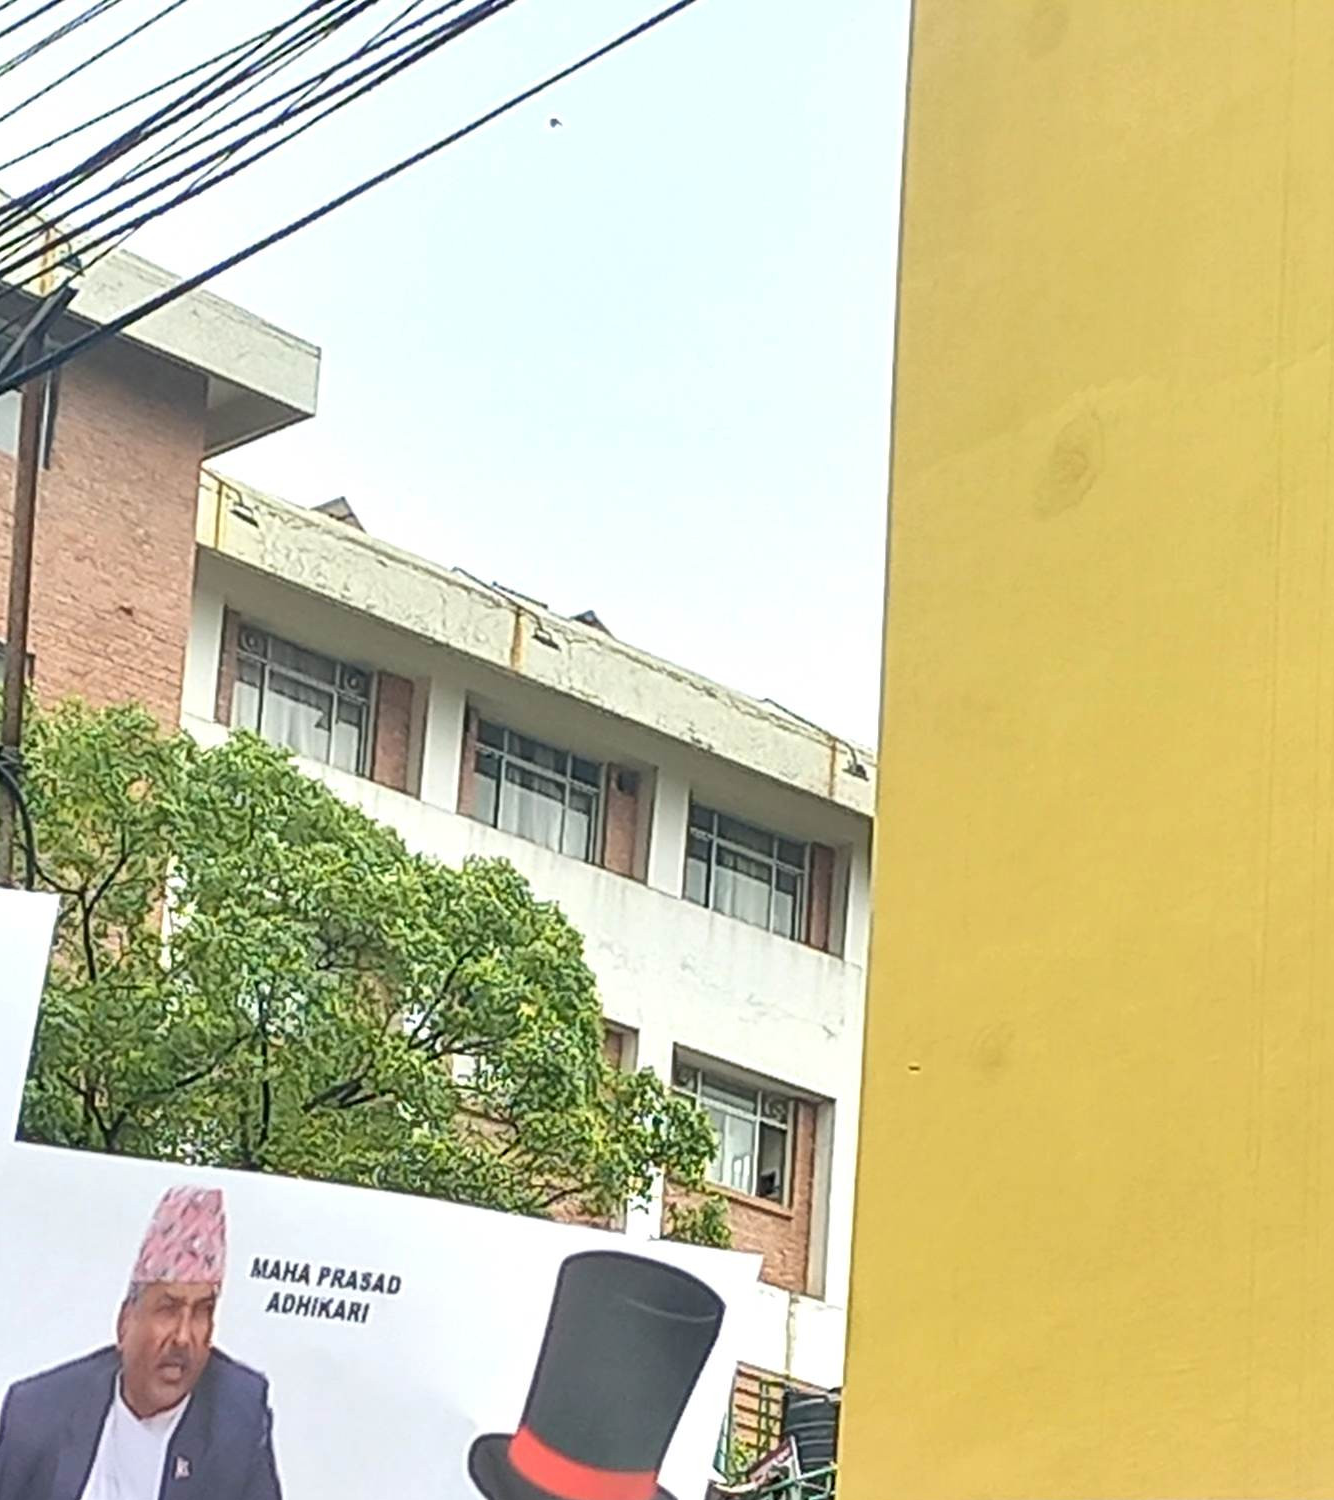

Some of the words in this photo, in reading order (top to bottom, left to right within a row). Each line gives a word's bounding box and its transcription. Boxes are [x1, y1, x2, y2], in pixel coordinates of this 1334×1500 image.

[250, 1258, 310, 1286] MAHA
[316, 1267, 401, 1294] PRASAD
[265, 1292, 369, 1323] ADHIKARI
